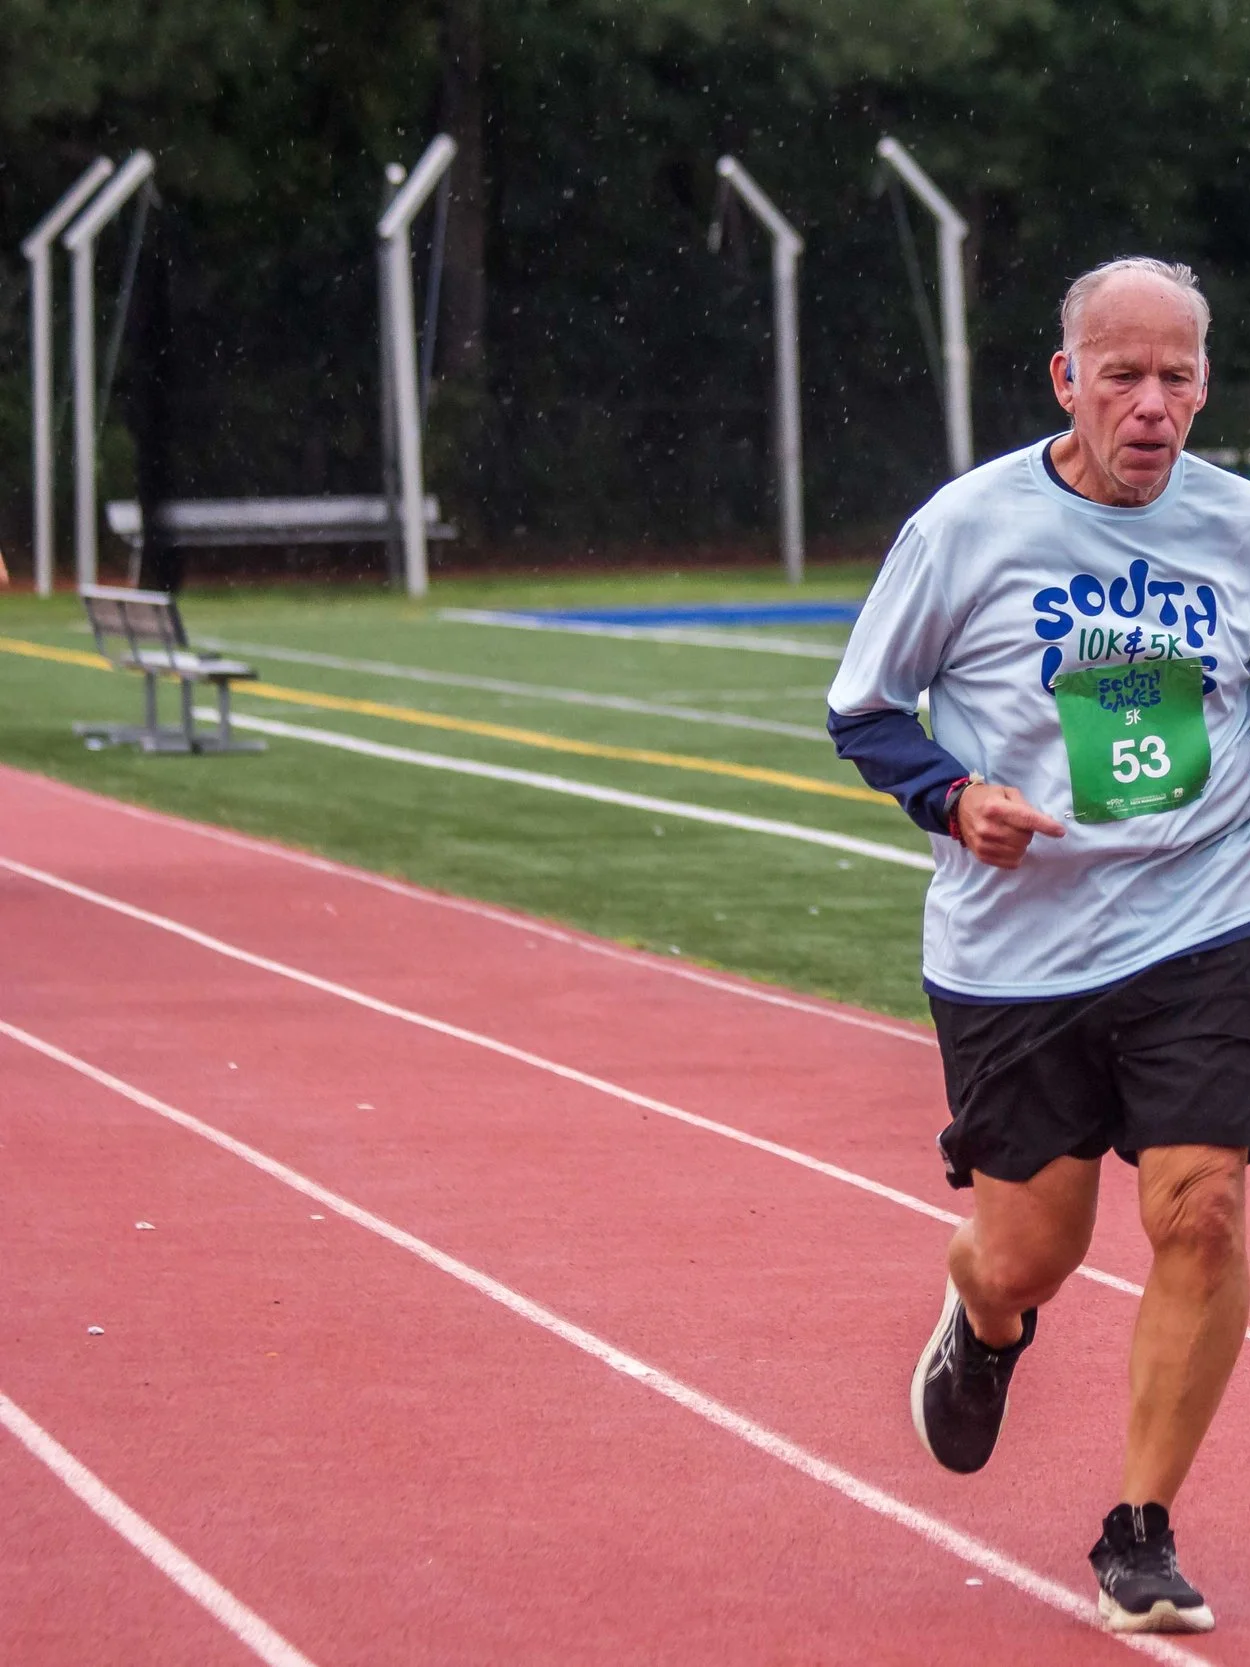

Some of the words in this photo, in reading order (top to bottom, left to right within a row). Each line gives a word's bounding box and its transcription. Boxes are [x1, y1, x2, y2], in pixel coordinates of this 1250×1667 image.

[1033, 559, 1217, 648] SOUTH
[1099, 669, 1160, 693] SOUTH
[1100, 688, 1162, 713] LAKES
[1125, 709, 1142, 725] 5K
[1112, 735, 1171, 783] 53
